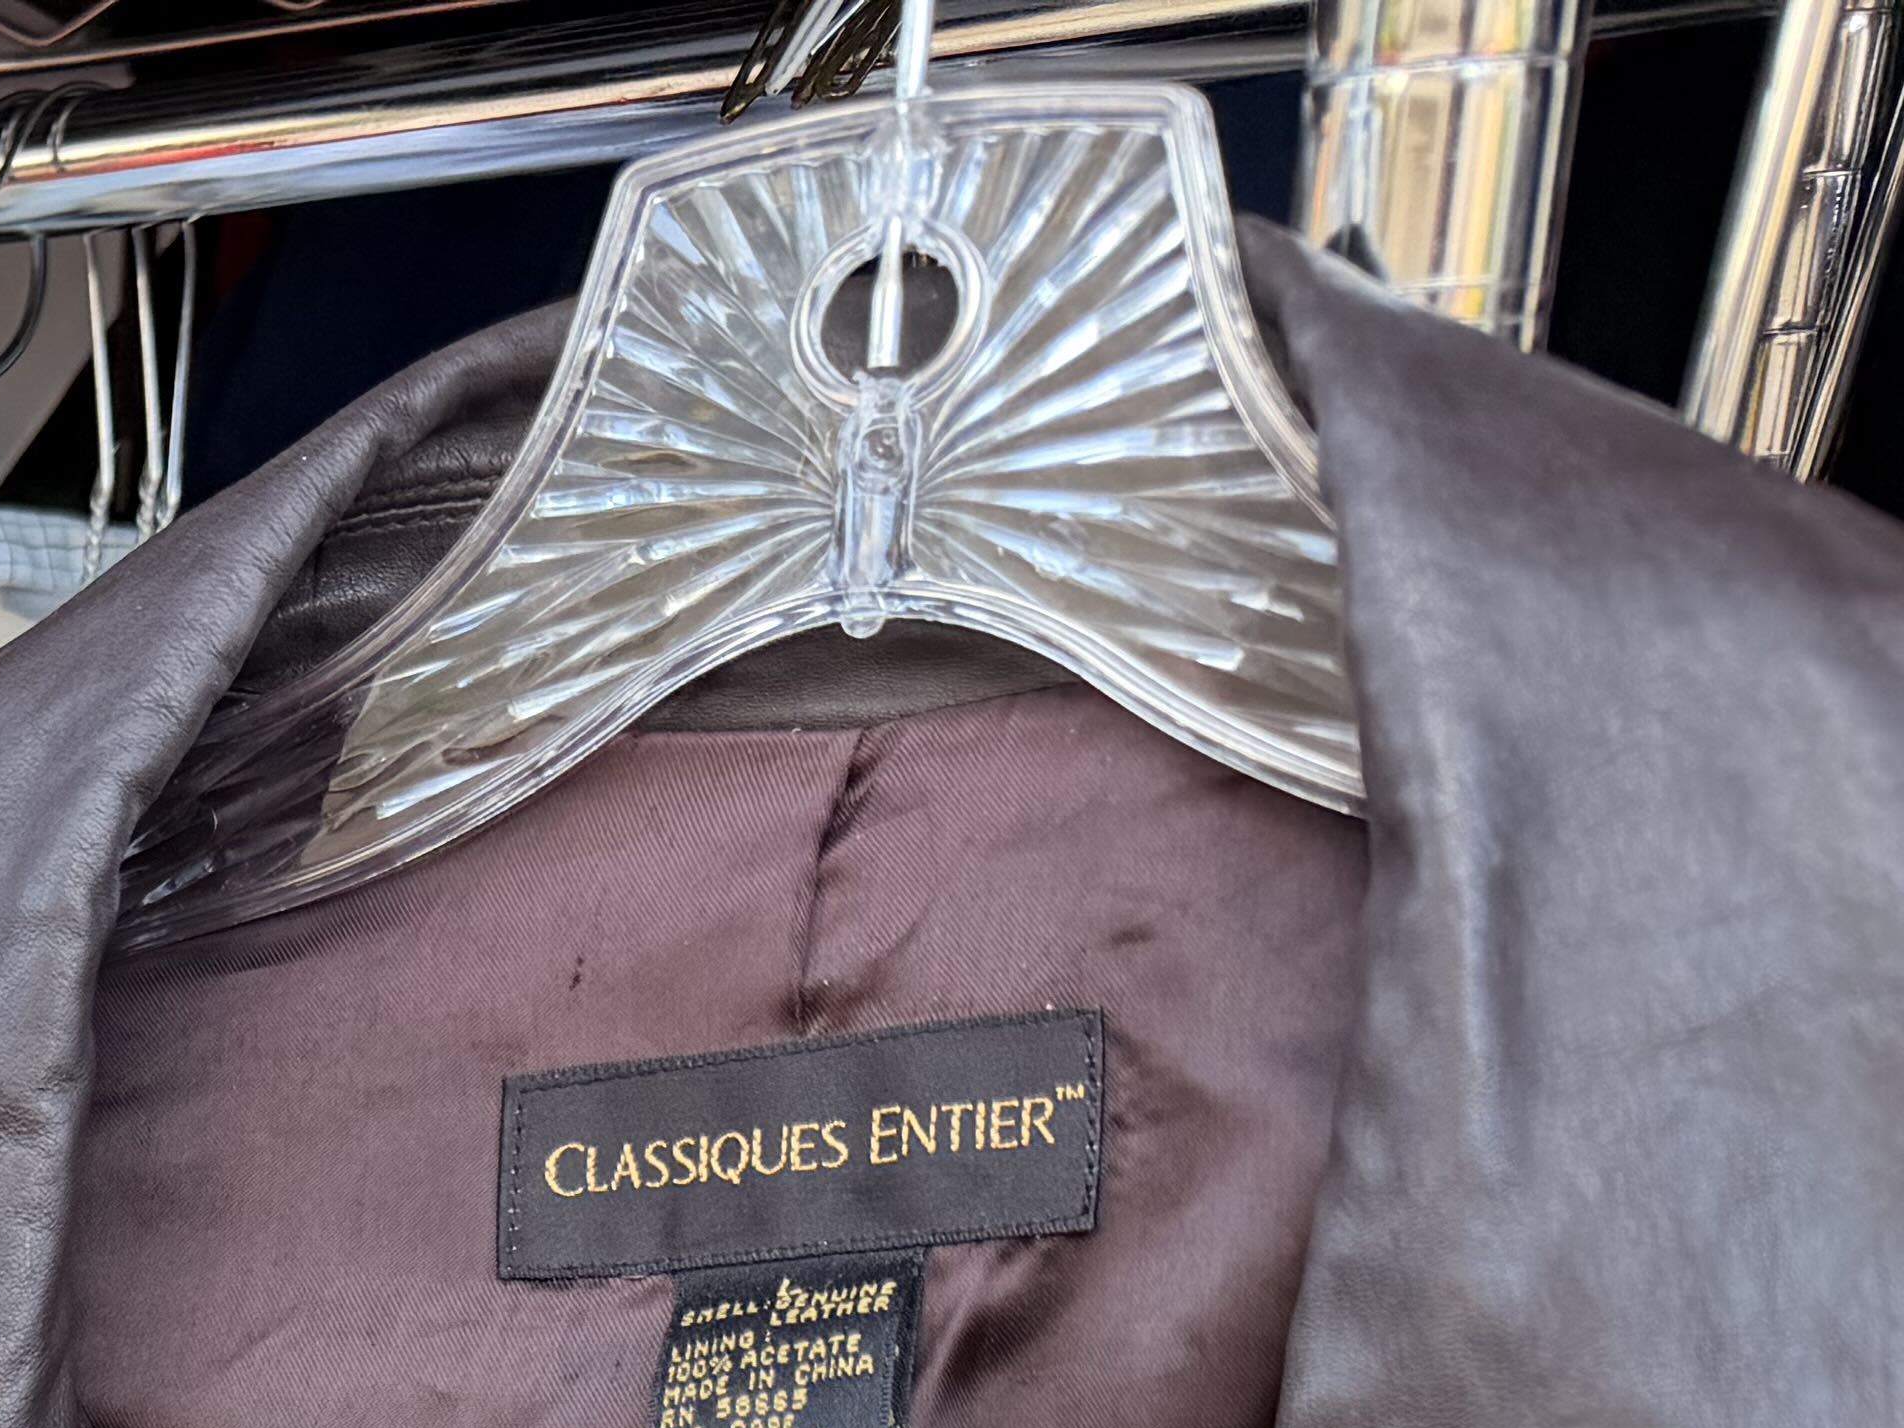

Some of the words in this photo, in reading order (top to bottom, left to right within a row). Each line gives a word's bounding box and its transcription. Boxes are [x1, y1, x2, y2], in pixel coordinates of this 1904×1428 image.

[544, 1119, 849, 1198] CLASSIQUES
[770, 1295, 891, 1327] LEATHER
[775, 1277, 897, 1310] GENUINE
[663, 1374, 730, 1408] MADE
[748, 1368, 776, 1391] IN
[794, 1354, 875, 1387] CHINA
[668, 1354, 733, 1383] 100%
[740, 1332, 862, 1370] ACETATE
